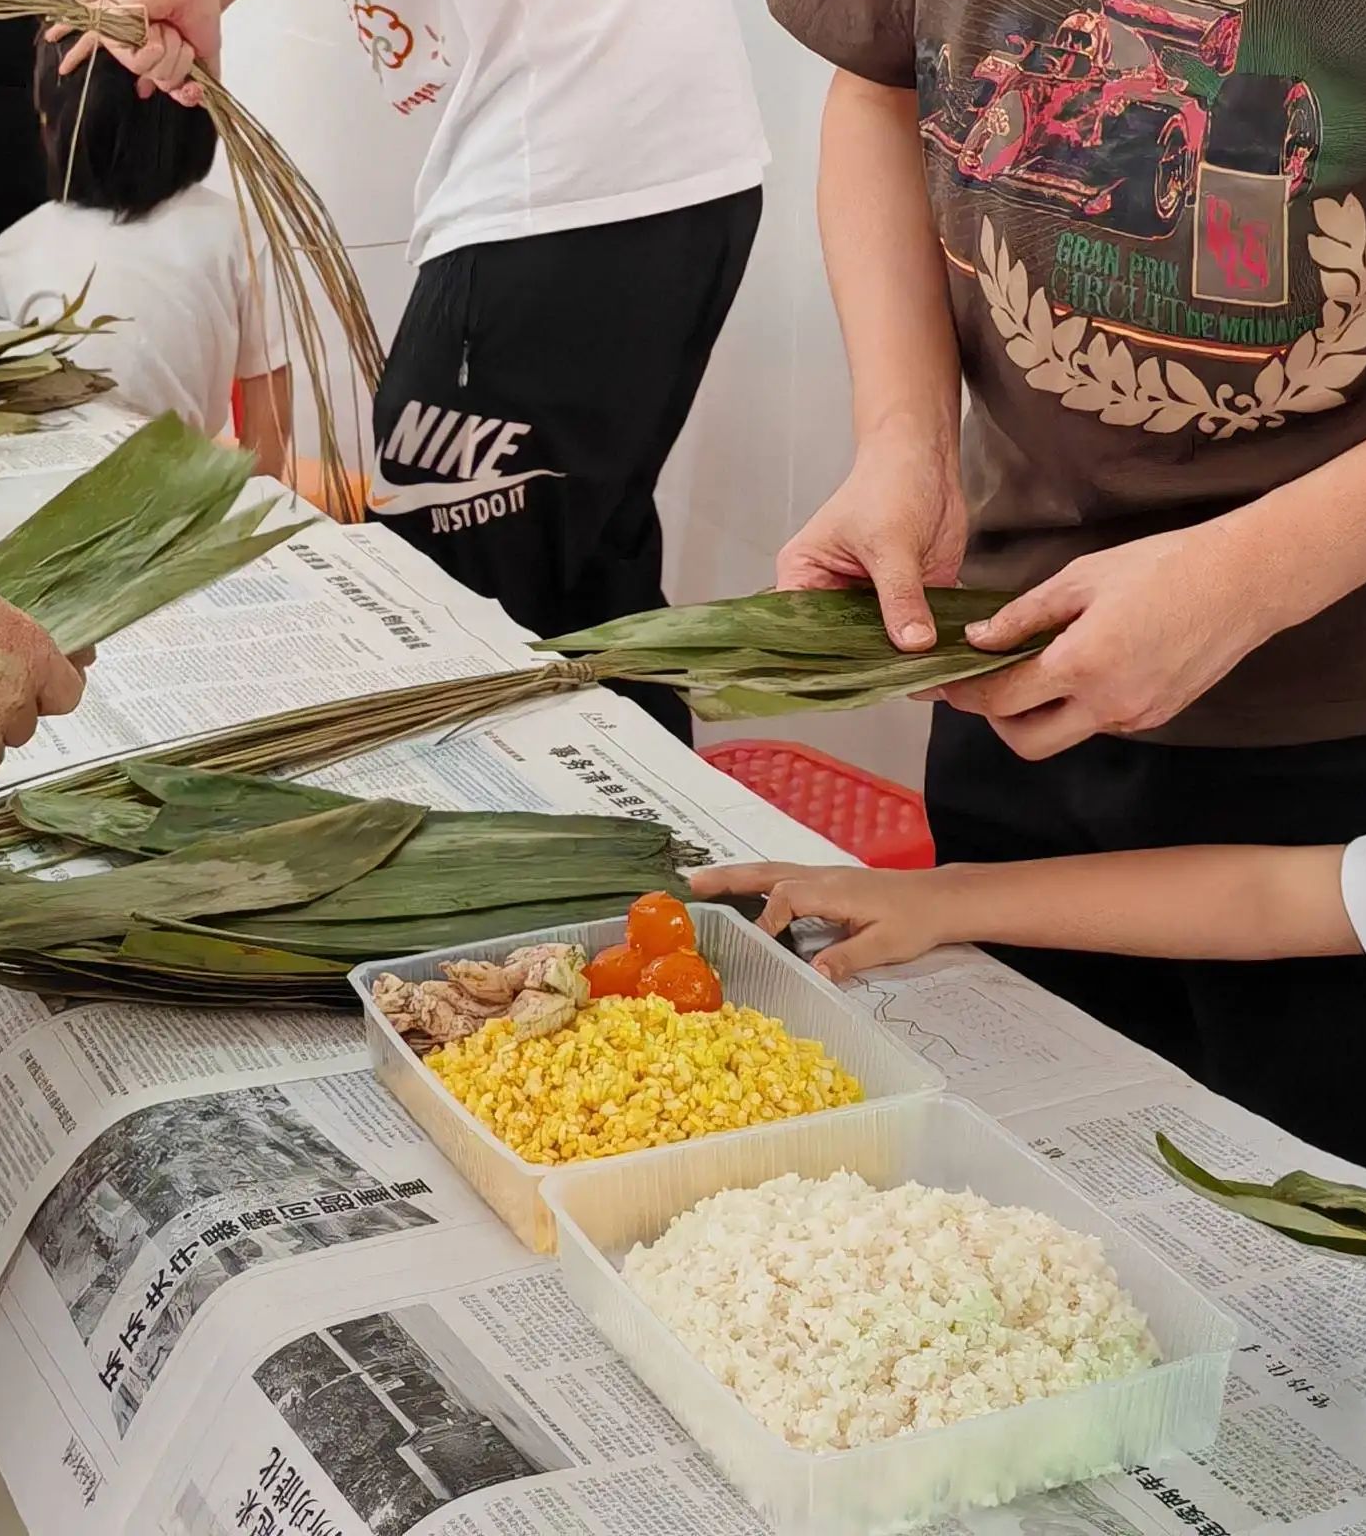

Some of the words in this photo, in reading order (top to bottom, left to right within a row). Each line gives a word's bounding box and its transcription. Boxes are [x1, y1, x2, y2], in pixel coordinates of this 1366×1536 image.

[384, 399, 532, 480] NIKE
[431, 505, 473, 534] JUST
[474, 497, 506, 526] DO
[509, 484, 526, 511] IT
